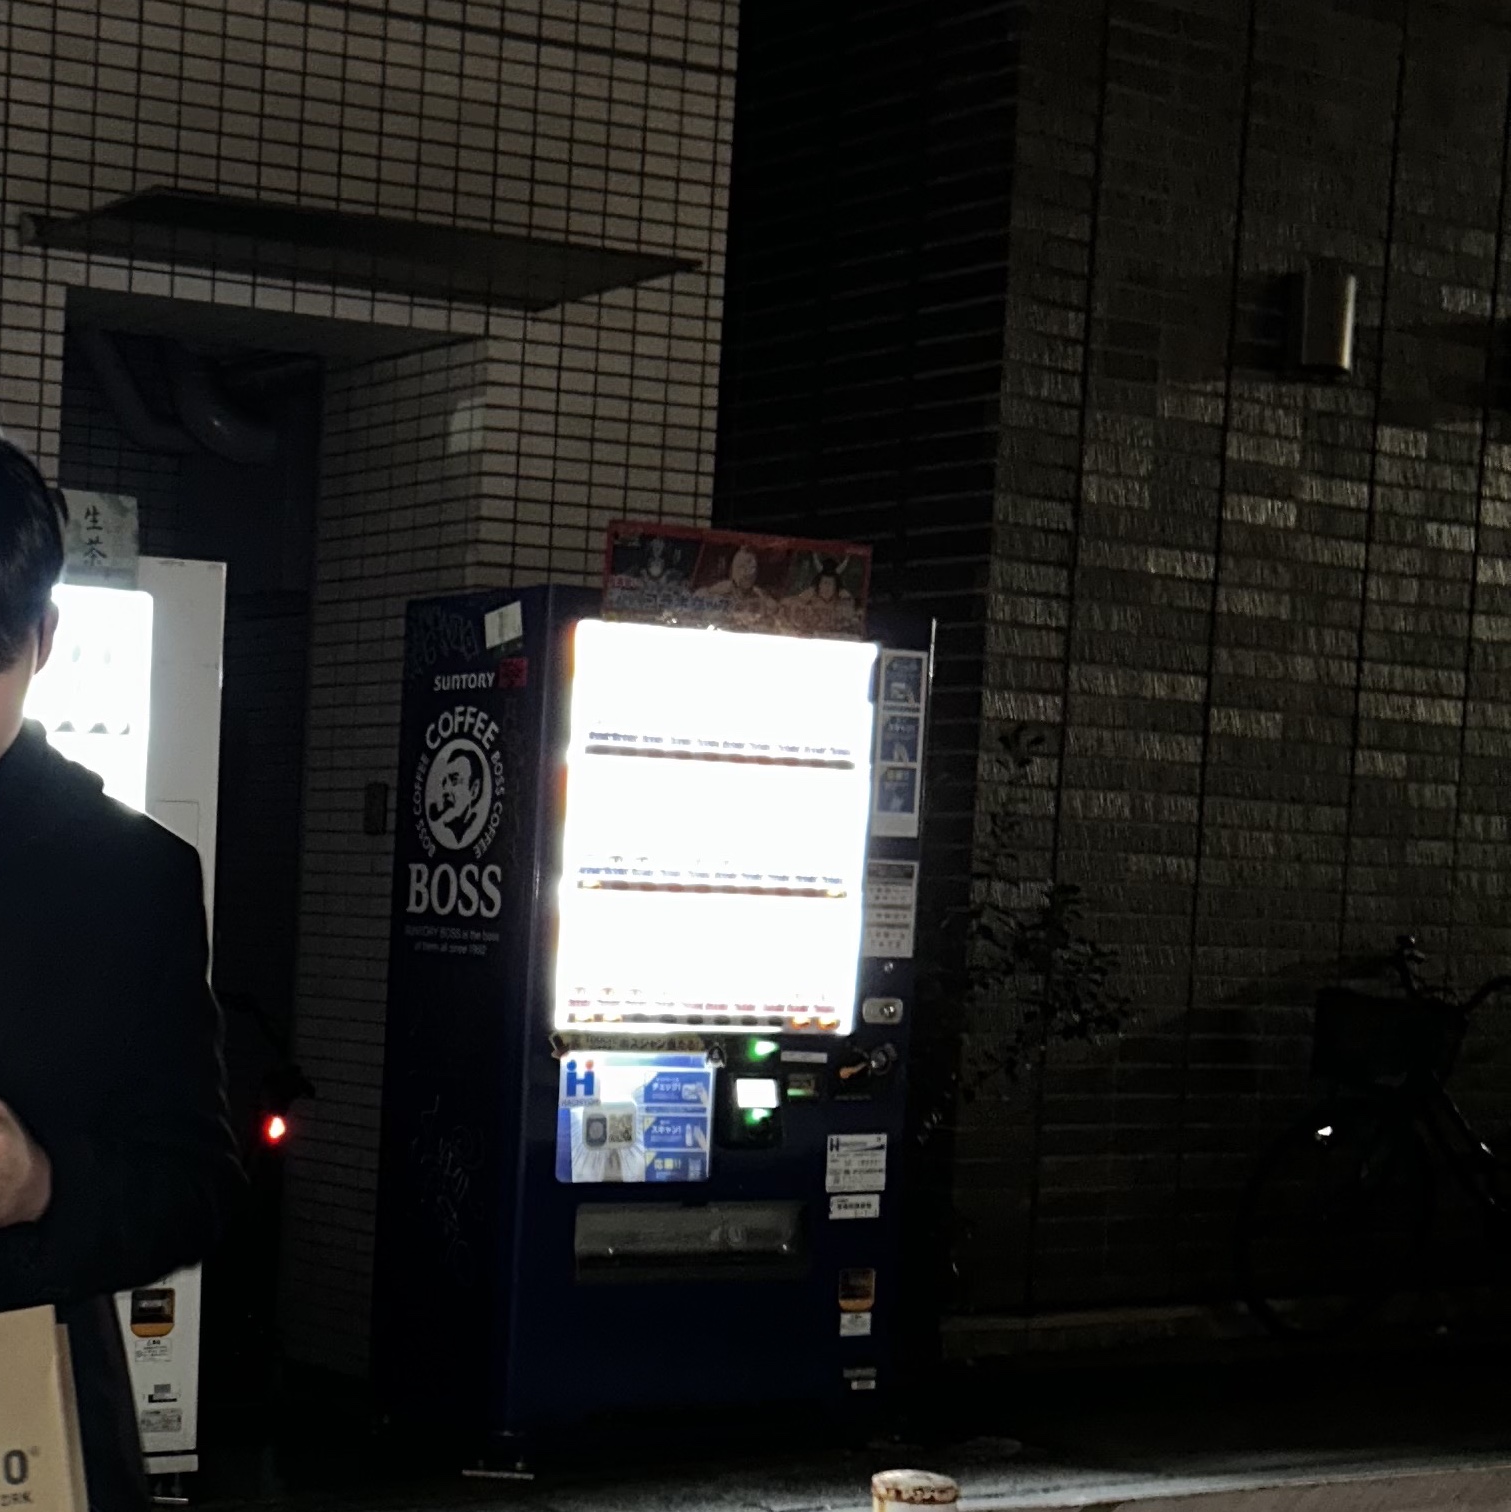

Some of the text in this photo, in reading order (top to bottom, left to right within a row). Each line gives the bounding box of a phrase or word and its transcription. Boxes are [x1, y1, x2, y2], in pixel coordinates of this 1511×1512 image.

[83, 505, 107, 567] 生茶
[425, 705, 500, 750] COFFEE
[406, 863, 502, 918] BOSS
